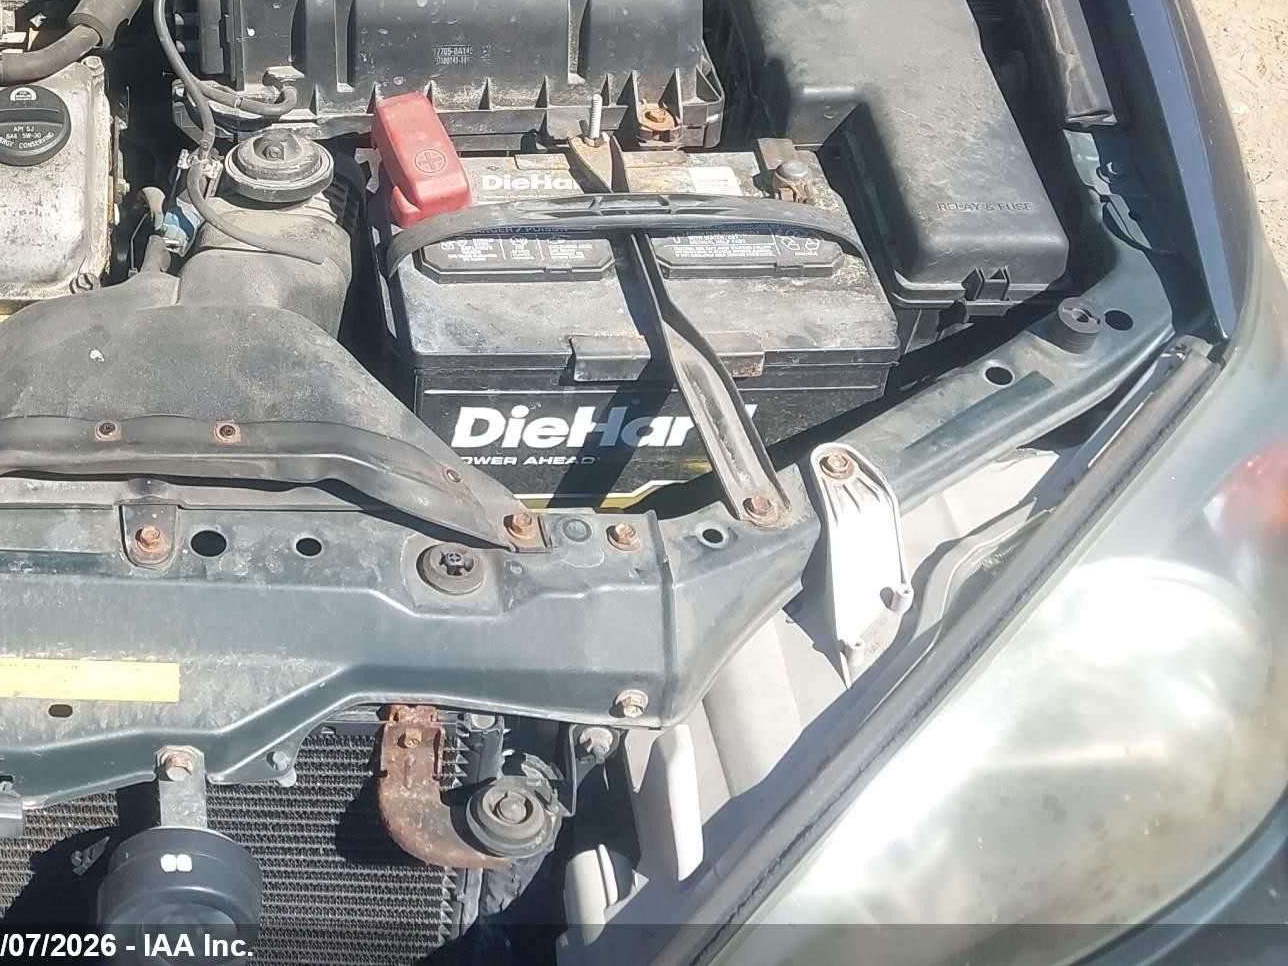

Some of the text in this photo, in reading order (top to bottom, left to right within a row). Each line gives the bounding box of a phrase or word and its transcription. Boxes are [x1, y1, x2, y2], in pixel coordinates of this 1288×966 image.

[18, 131, 55, 149] CONSERVING
[936, 201, 982, 212] RELAY
[998, 201, 1034, 212] FUSE
[450, 403, 758, 448] DieHar
[523, 456, 597, 465] AHEAD
